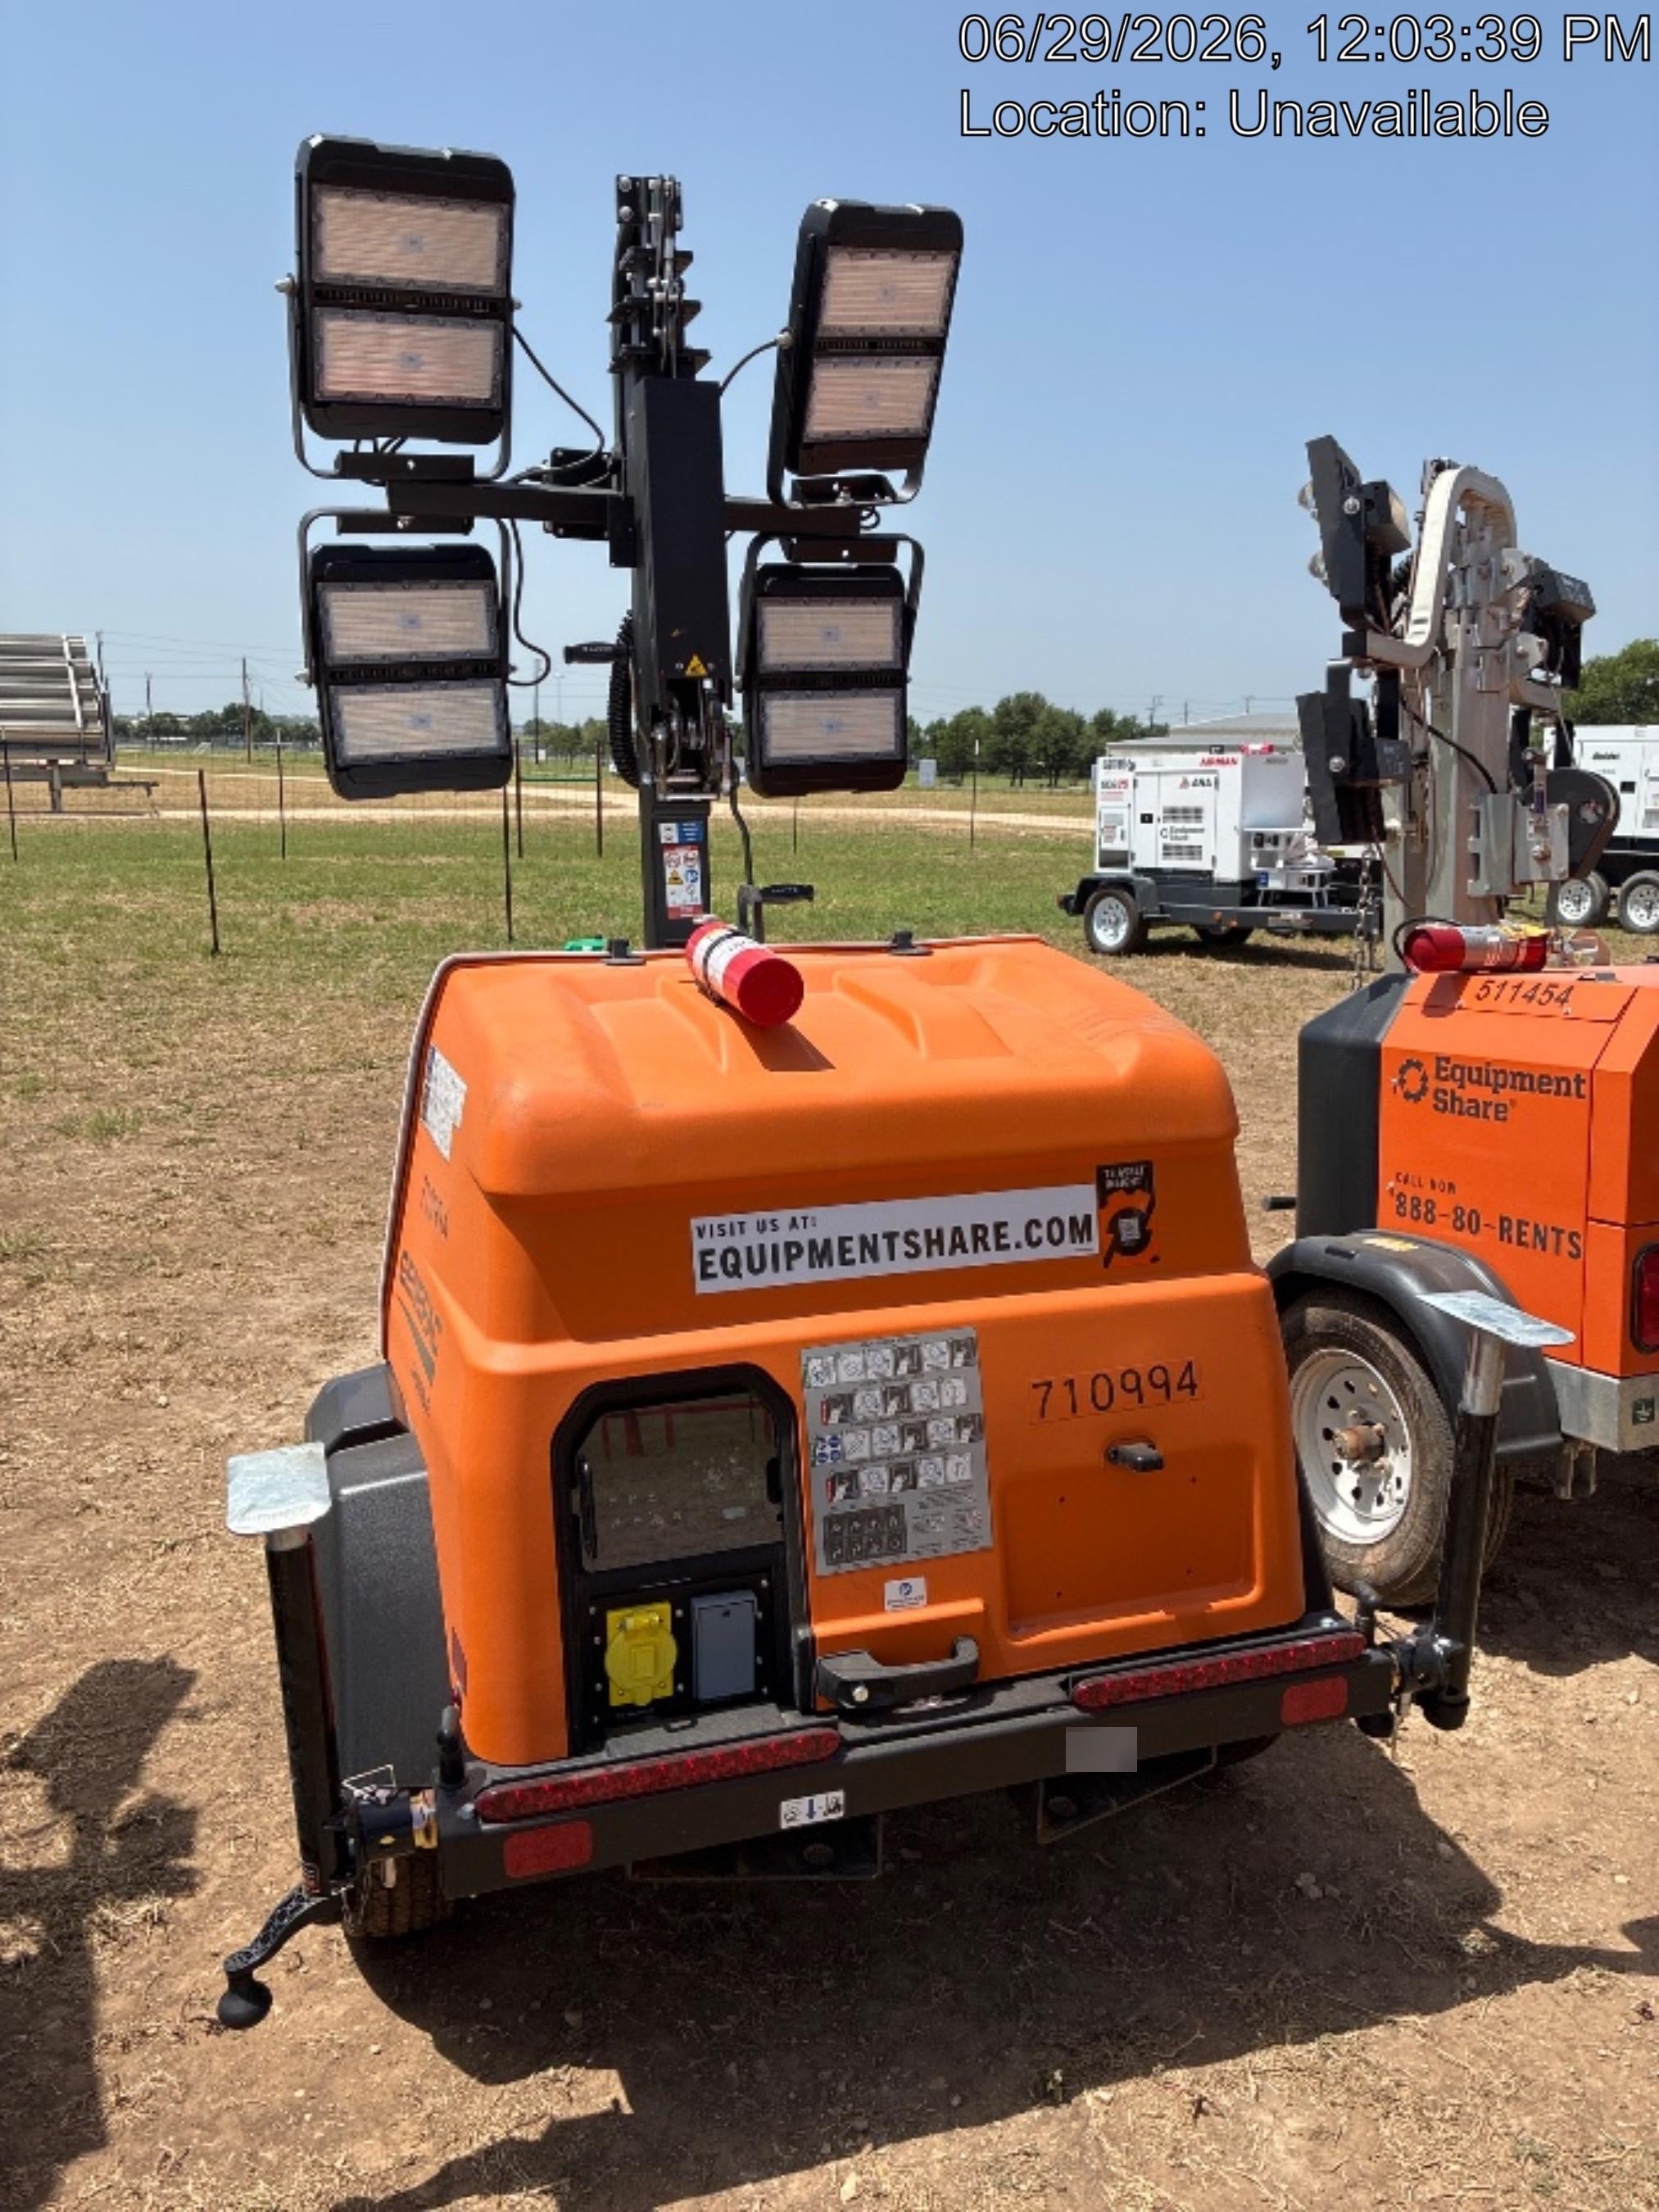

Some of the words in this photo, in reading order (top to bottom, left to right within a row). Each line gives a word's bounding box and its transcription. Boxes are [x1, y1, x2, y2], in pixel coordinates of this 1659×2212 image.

[1475, 979, 1574, 1006] 511454
[1434, 1055, 1587, 1099] Equipment
[696, 1221, 746, 1240] VISIT
[756, 1217, 780, 1235] US
[788, 1215, 818, 1232] AT:
[698, 1213, 1094, 1281] EQUIPMENTSHARE.COM
[1395, 1191, 1583, 1260] 888-80-RENTS
[1031, 1361, 1199, 1419] 710994
